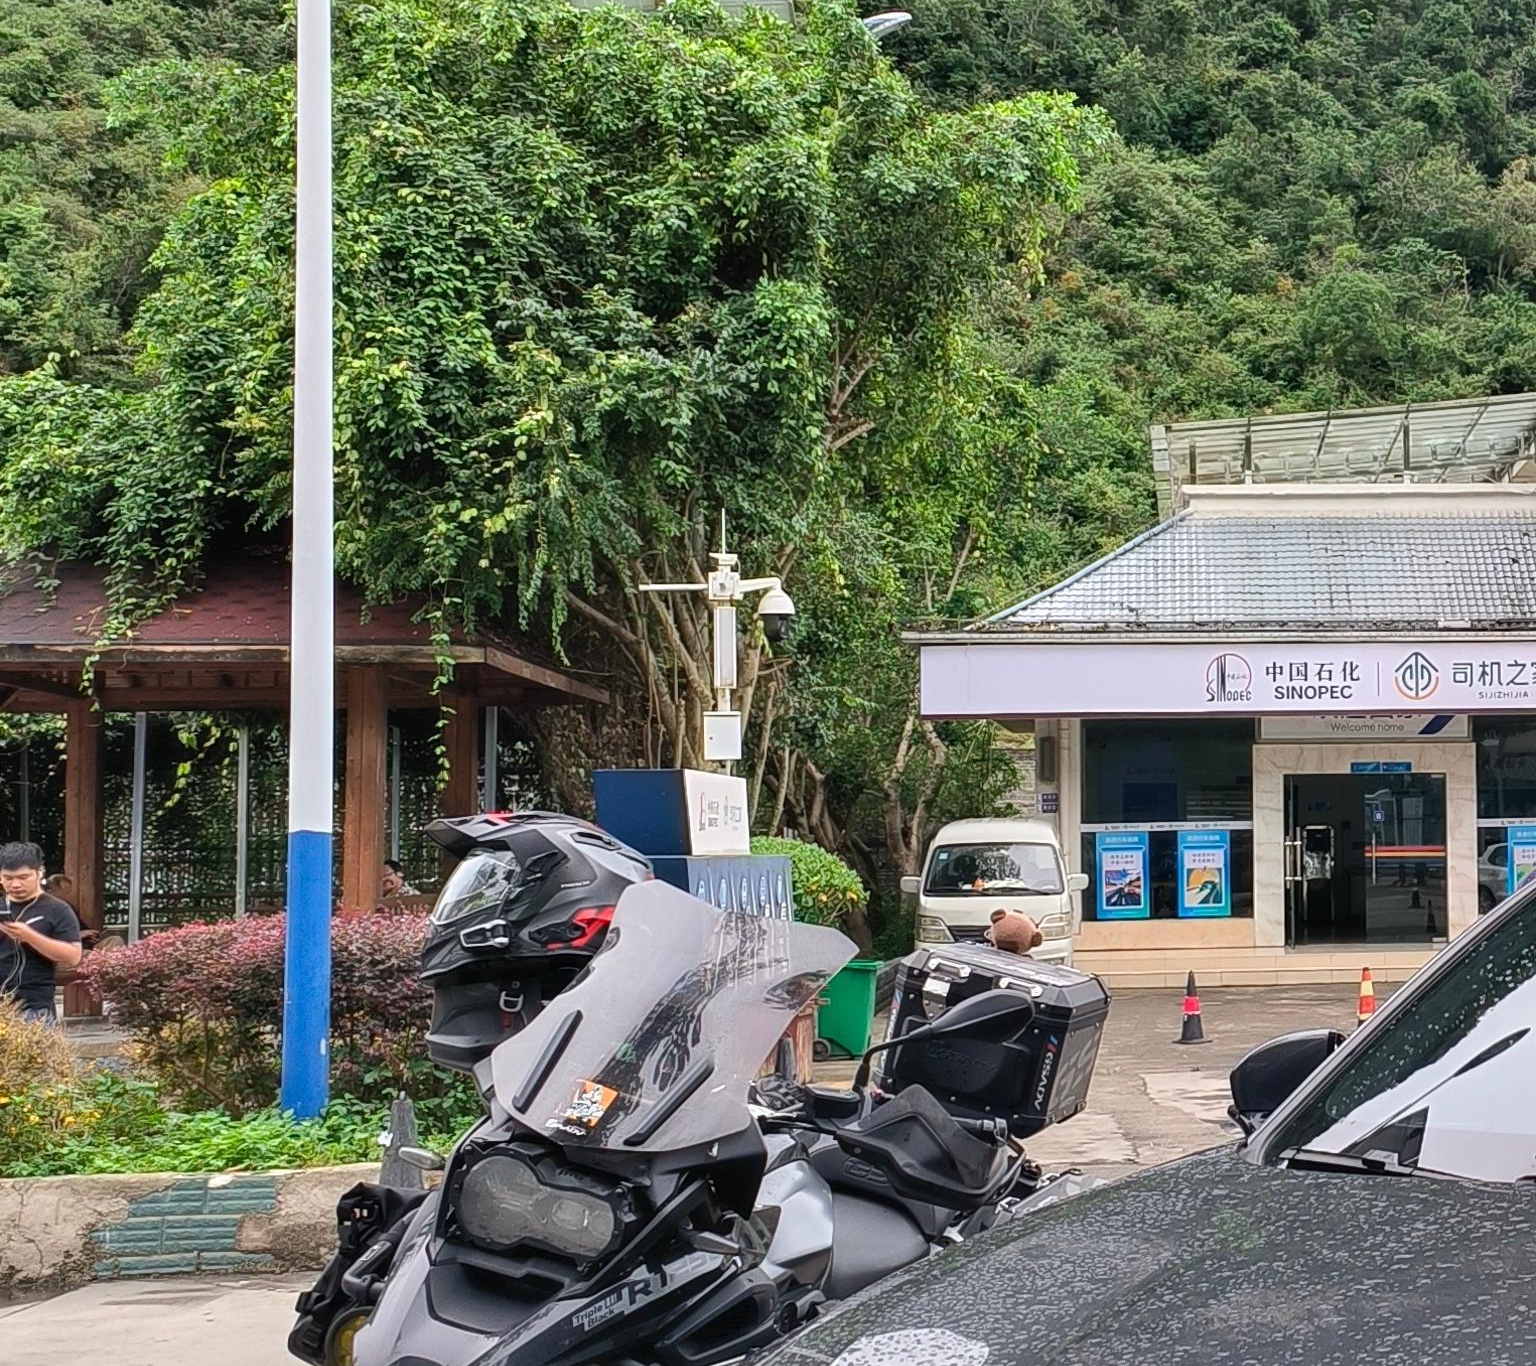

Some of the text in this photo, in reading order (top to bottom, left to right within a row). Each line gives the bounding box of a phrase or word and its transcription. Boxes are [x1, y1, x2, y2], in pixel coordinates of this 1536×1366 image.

[1265, 661, 1361, 683] 中国石化
[1274, 685, 1354, 700] SINOPEC
[1478, 690, 1530, 700] SIJIZHIJIA
[1330, 722, 1405, 733] Welcome home
[573, 1304, 604, 1325] Triple
[587, 1307, 616, 1328] Black
